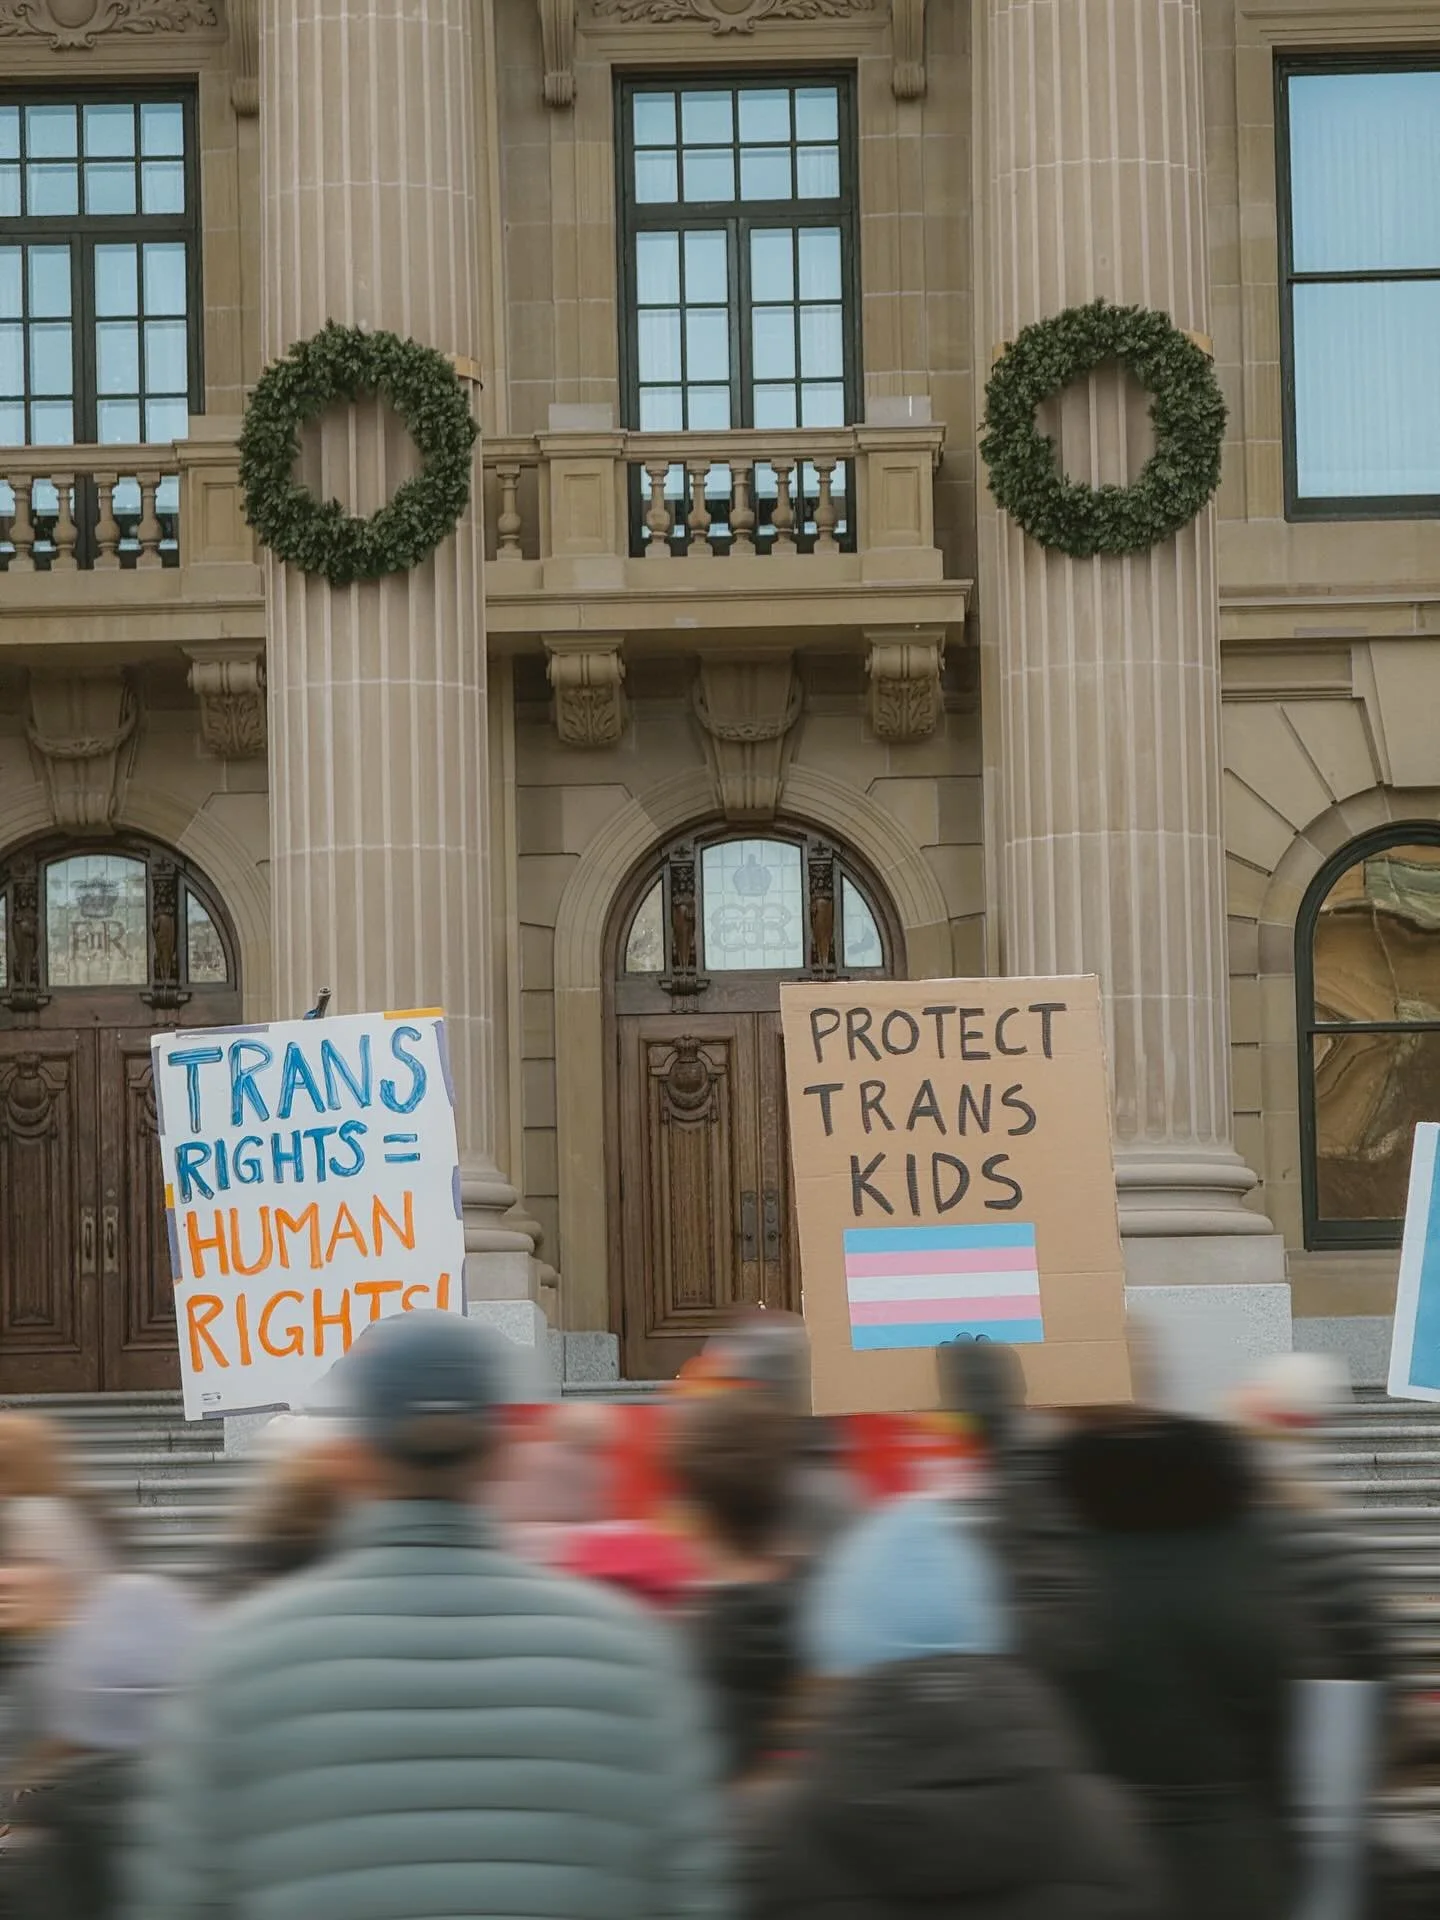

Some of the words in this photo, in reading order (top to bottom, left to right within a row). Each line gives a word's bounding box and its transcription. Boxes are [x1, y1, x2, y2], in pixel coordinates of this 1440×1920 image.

[809, 1002, 1067, 1064] PROTECT
[167, 1026, 427, 1132] TRANS
[802, 1078, 1037, 1137] TRANS
[175, 1119, 369, 1202] RIGHTS
[849, 1151, 1023, 1217] KIDS
[186, 1191, 416, 1279] HUMAN
